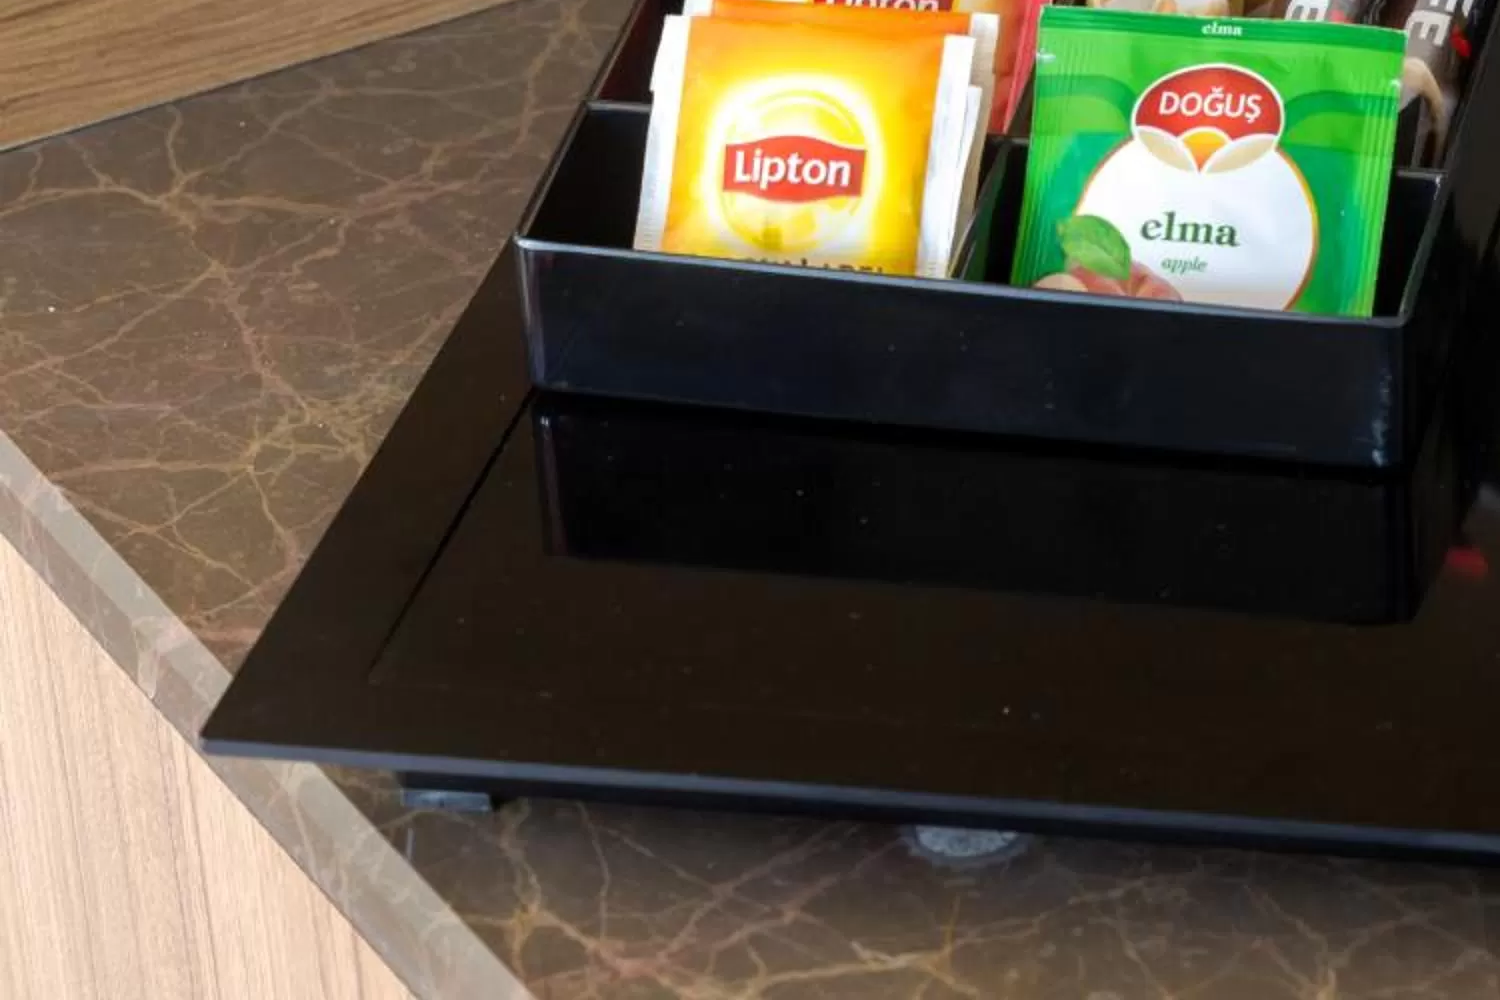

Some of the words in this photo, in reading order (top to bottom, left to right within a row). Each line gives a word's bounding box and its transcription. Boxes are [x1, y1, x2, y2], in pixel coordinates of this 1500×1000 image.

[1201, 20, 1243, 37] elma
[1158, 86, 1263, 124] DOĞUŞ
[734, 148, 852, 190] Lipton
[1140, 210, 1241, 248] elma
[1161, 256, 1208, 275] apple
